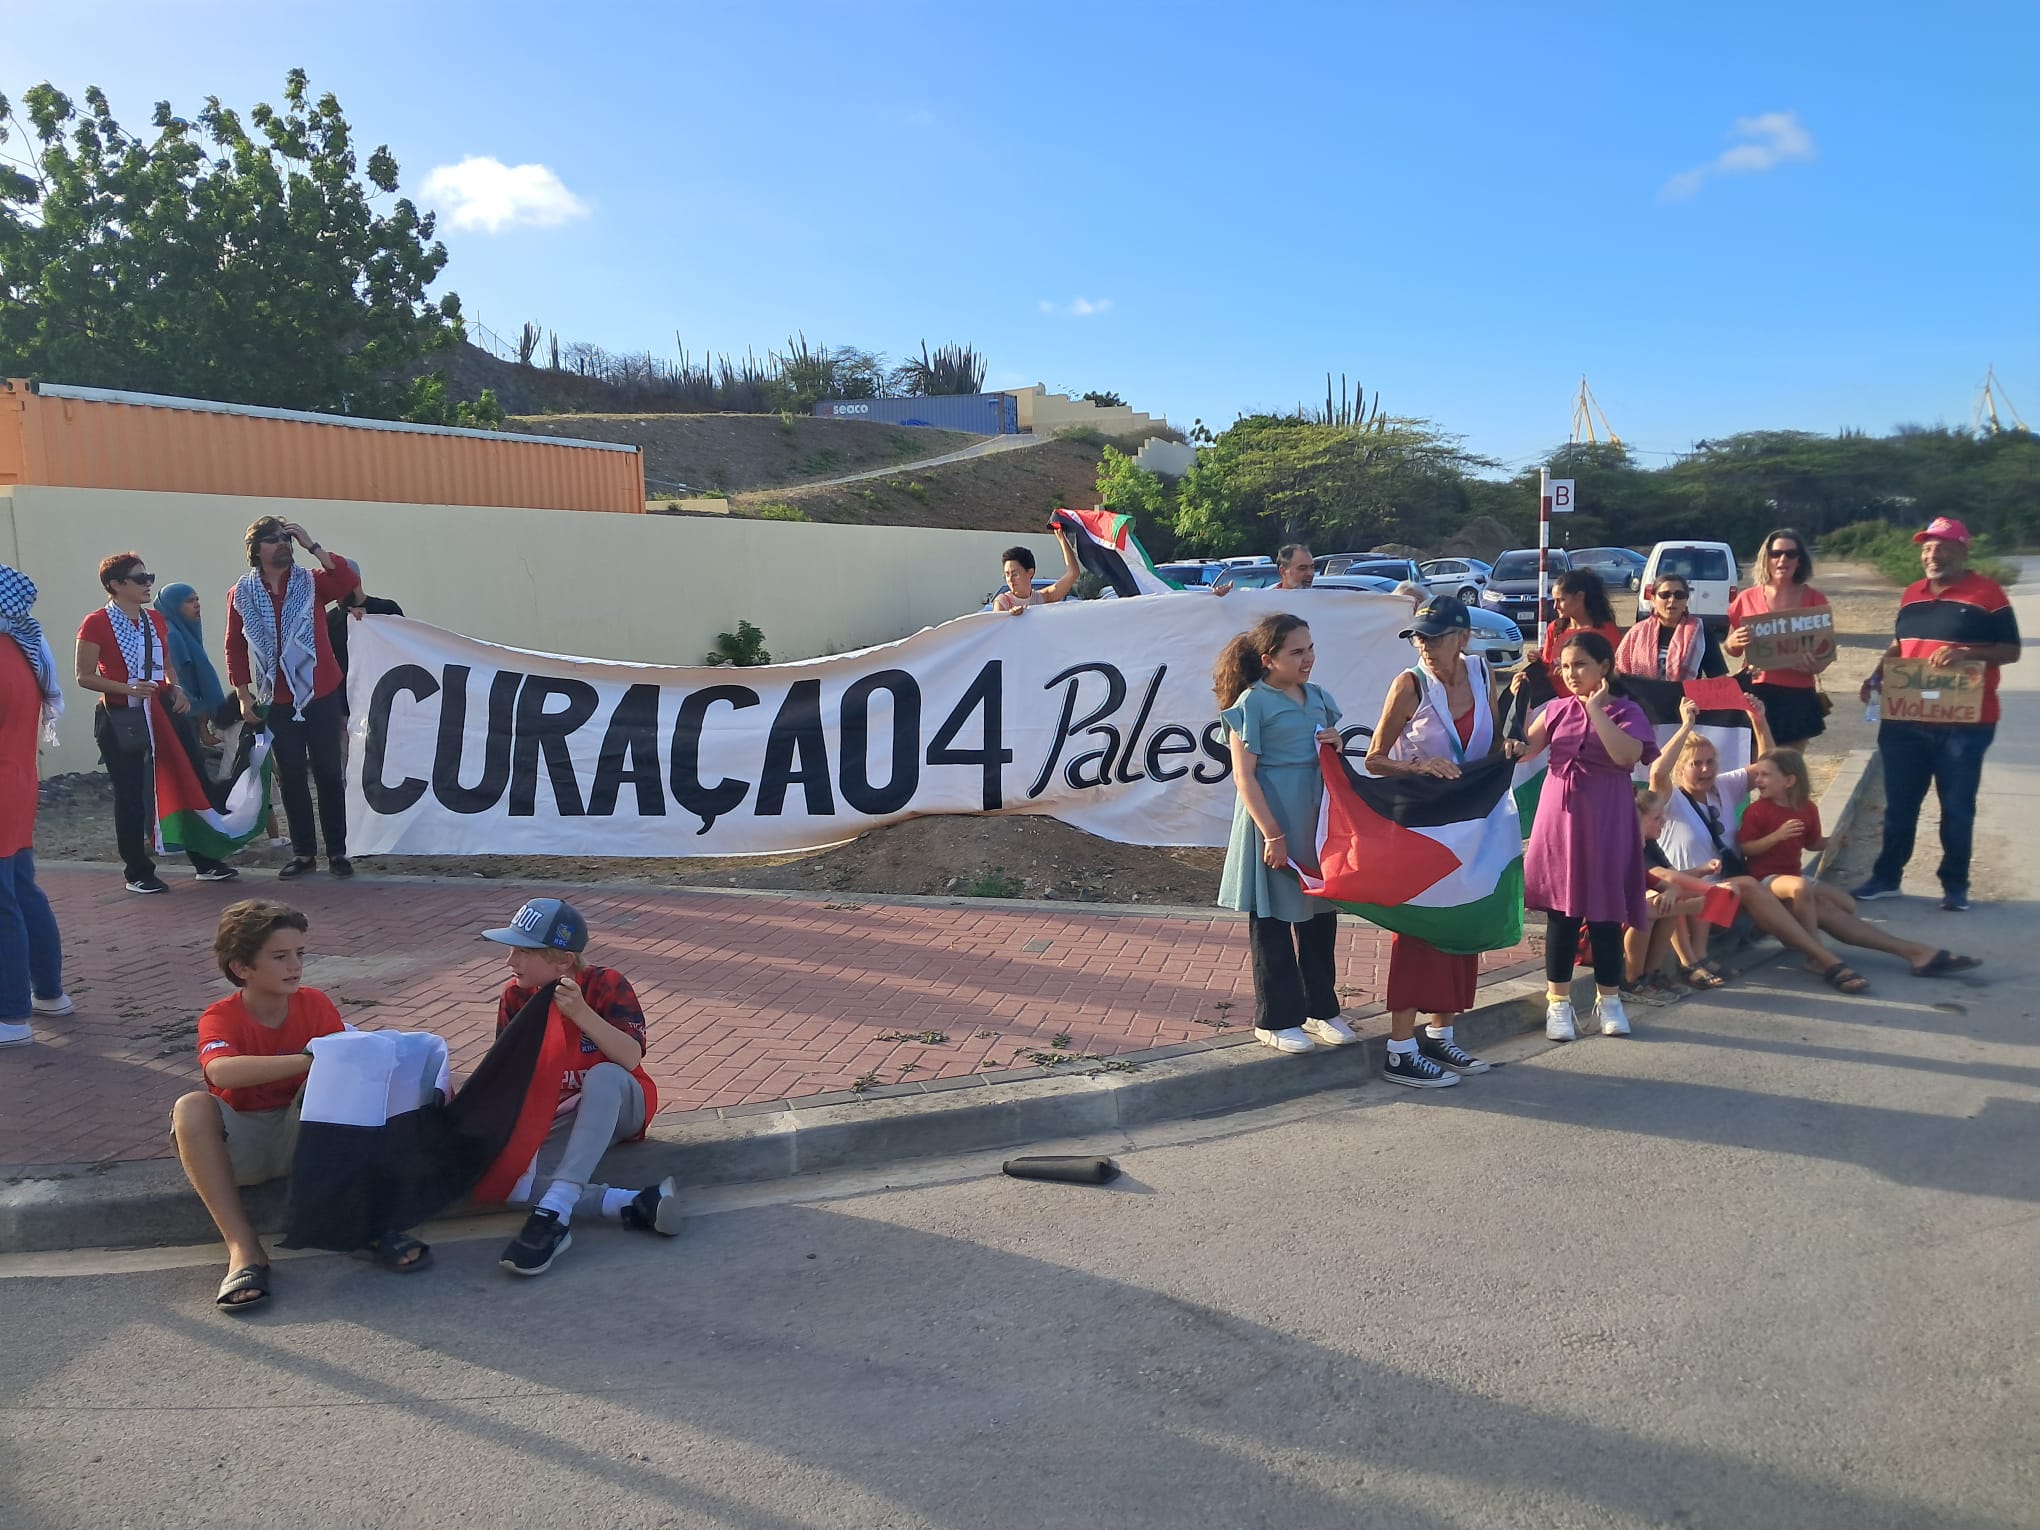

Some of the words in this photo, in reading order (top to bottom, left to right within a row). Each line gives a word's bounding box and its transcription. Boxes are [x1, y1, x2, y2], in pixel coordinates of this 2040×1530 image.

[833, 403, 869, 415] seaco
[1555, 485, 1570, 506] B
[1791, 613, 1831, 633] MEER
[1026, 660, 1375, 800] Palese
